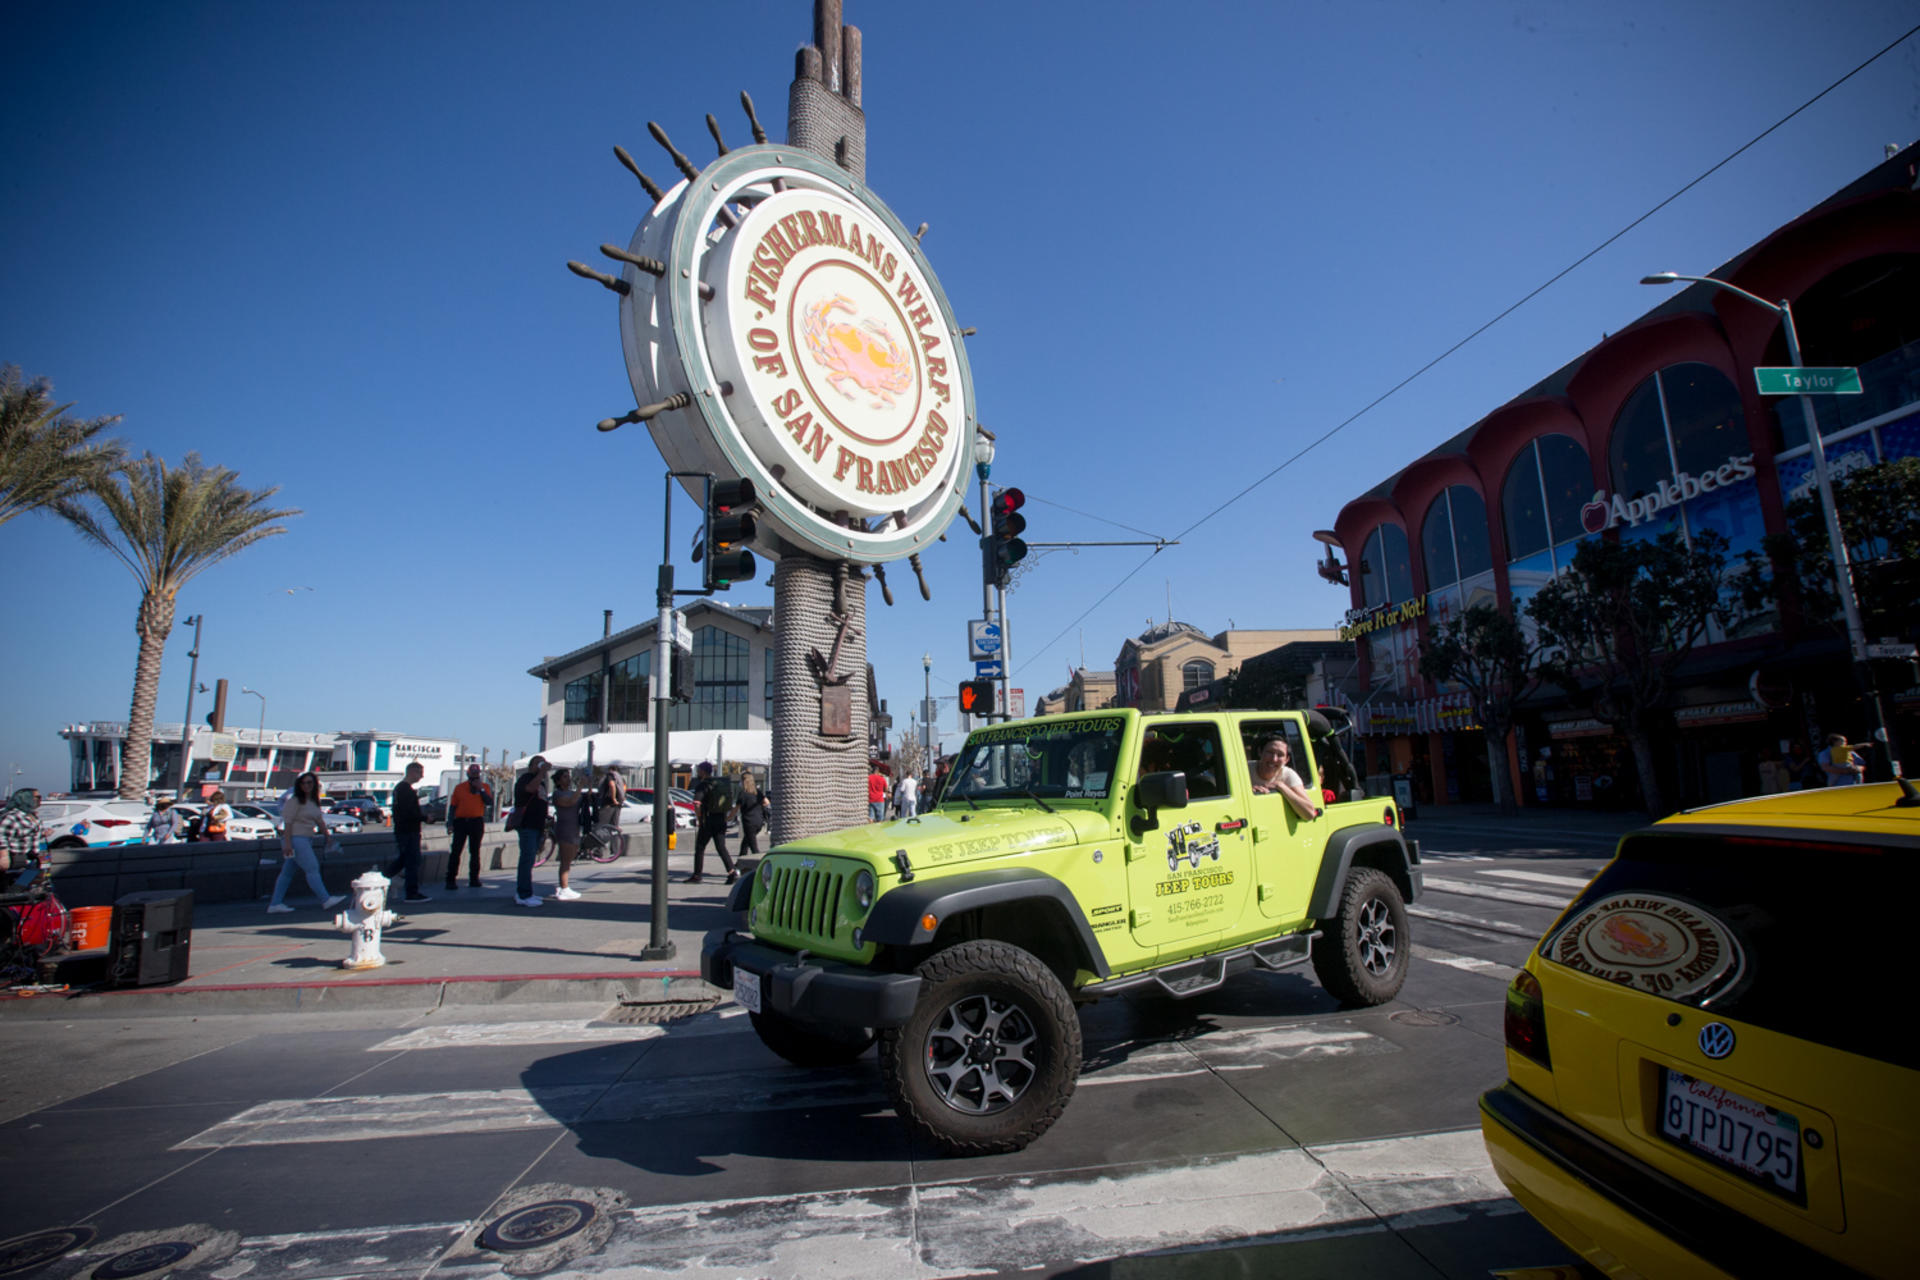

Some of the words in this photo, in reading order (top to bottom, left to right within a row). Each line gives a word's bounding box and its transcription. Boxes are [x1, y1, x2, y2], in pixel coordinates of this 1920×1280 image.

[744, 209, 898, 314] FISHERMANS
[896, 271, 951, 403] WHARF
[1782, 373, 1835, 390] Taylor
[747, 327, 789, 379] OF
[771, 388, 834, 464] SAN
[833, 408, 949, 496] FRANCISCO
[1339, 619, 1374, 642] Believe
[1375, 612, 1386, 630] It
[1386, 610, 1400, 625] or
[1400, 592, 1427, 624] Not!
[968, 734, 985, 746] SAN
[986, 724, 1048, 742] FRANCISCO
[1048, 722, 1076, 736] JEEP
[1075, 718, 1121, 733] TOURS
[1065, 790, 1083, 799] Point
[1084, 790, 1107, 800] Reyes
[927, 844, 953, 862] SF
[955, 836, 1001, 857] JEEP
[1156, 880, 1190, 897] JEEP
[1193, 871, 1234, 890] TOURS
[1166, 871, 1182, 880] SAN
[1183, 865, 1224, 878] FRANCISCO
[1168, 894, 1224, 915] 415-766-2722
[1090, 918, 1127, 929] RANGLER
[1688, 1078, 1774, 1124] California
[1668, 1094, 1793, 1179] 8TPD795
